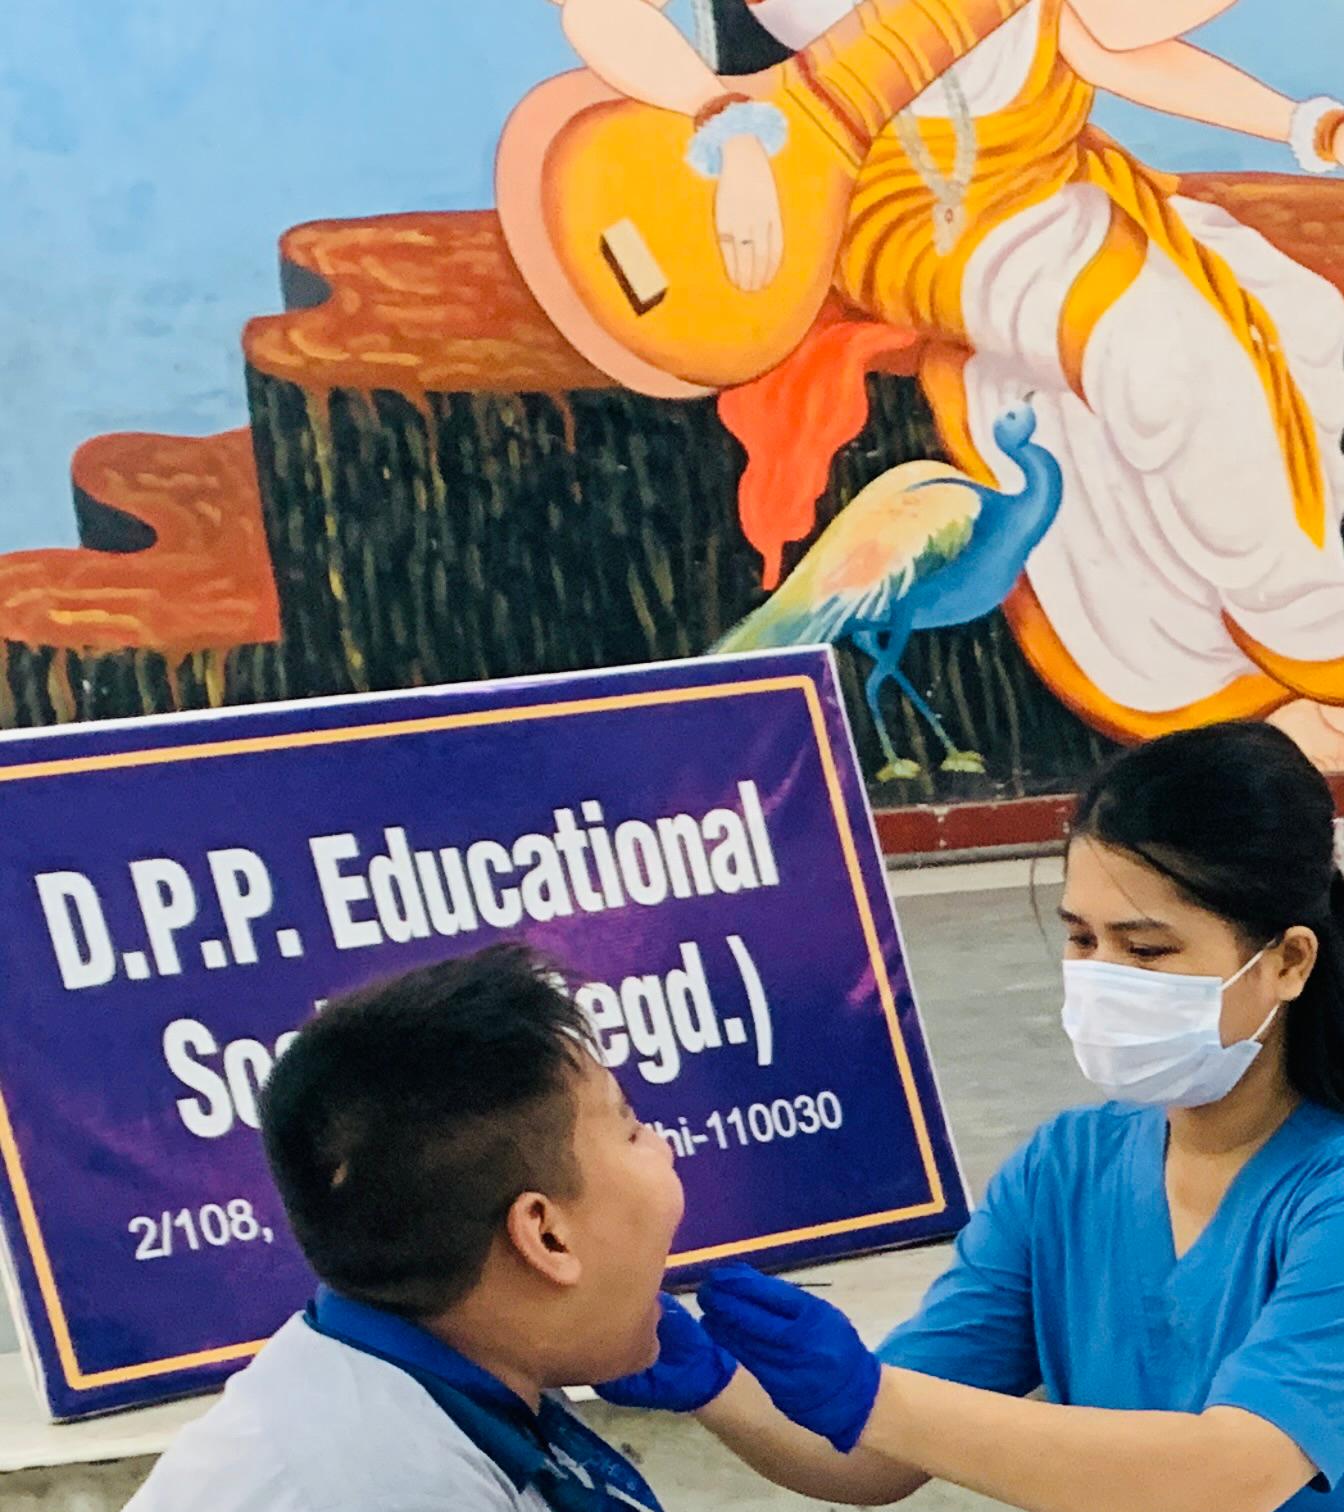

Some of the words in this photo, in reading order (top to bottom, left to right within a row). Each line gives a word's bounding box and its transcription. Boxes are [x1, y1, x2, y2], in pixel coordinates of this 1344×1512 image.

[36, 847, 304, 991] D.P.P.
[310, 780, 780, 949] Educational
[128, 1199, 273, 1262] 2/108,
